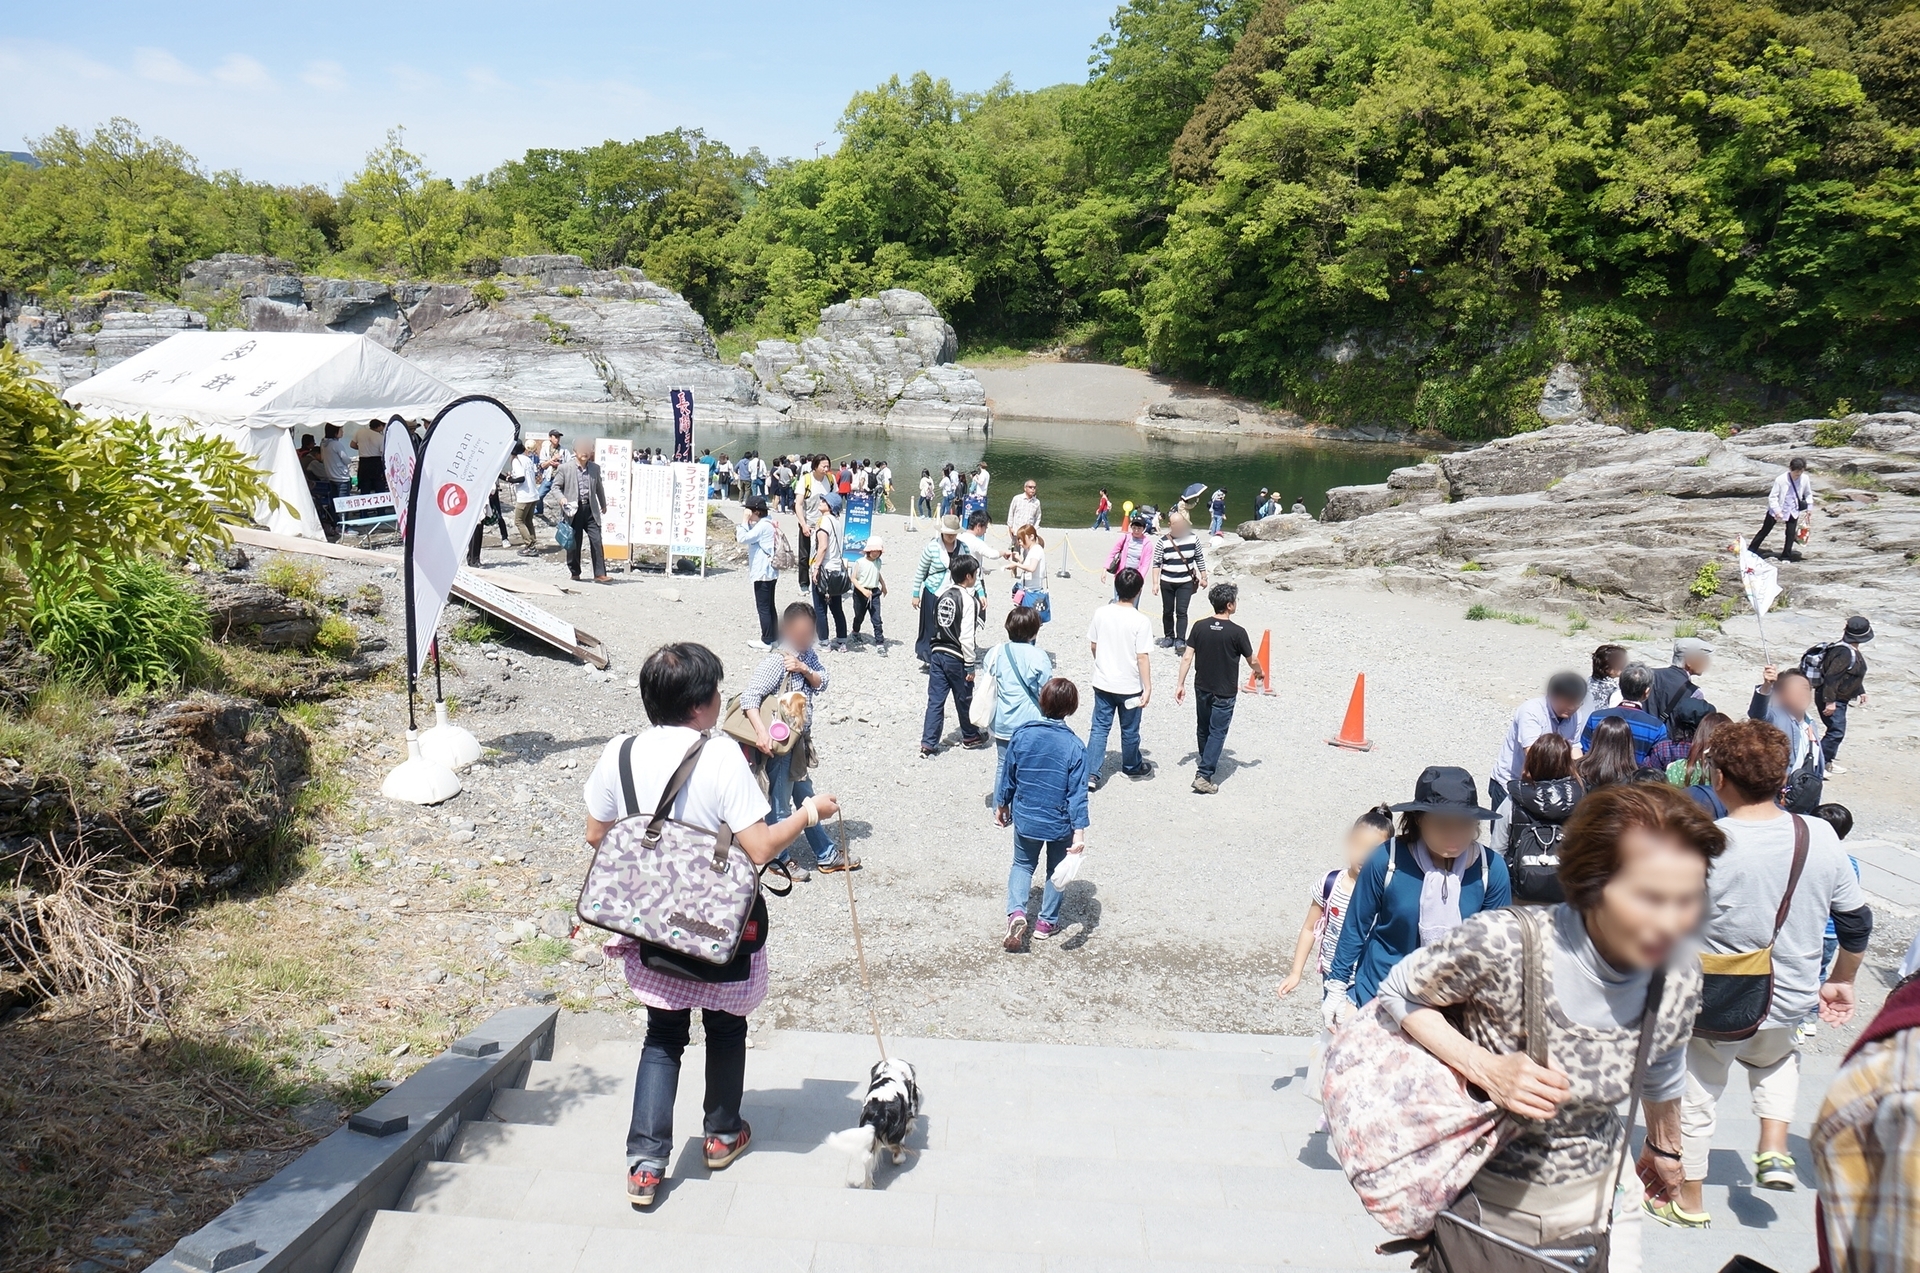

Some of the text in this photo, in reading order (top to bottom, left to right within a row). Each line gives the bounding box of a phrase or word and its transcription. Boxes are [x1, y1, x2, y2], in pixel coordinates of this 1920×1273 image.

[447, 433, 473, 478] Japan
[606, 445, 619, 533] 転倒注意
